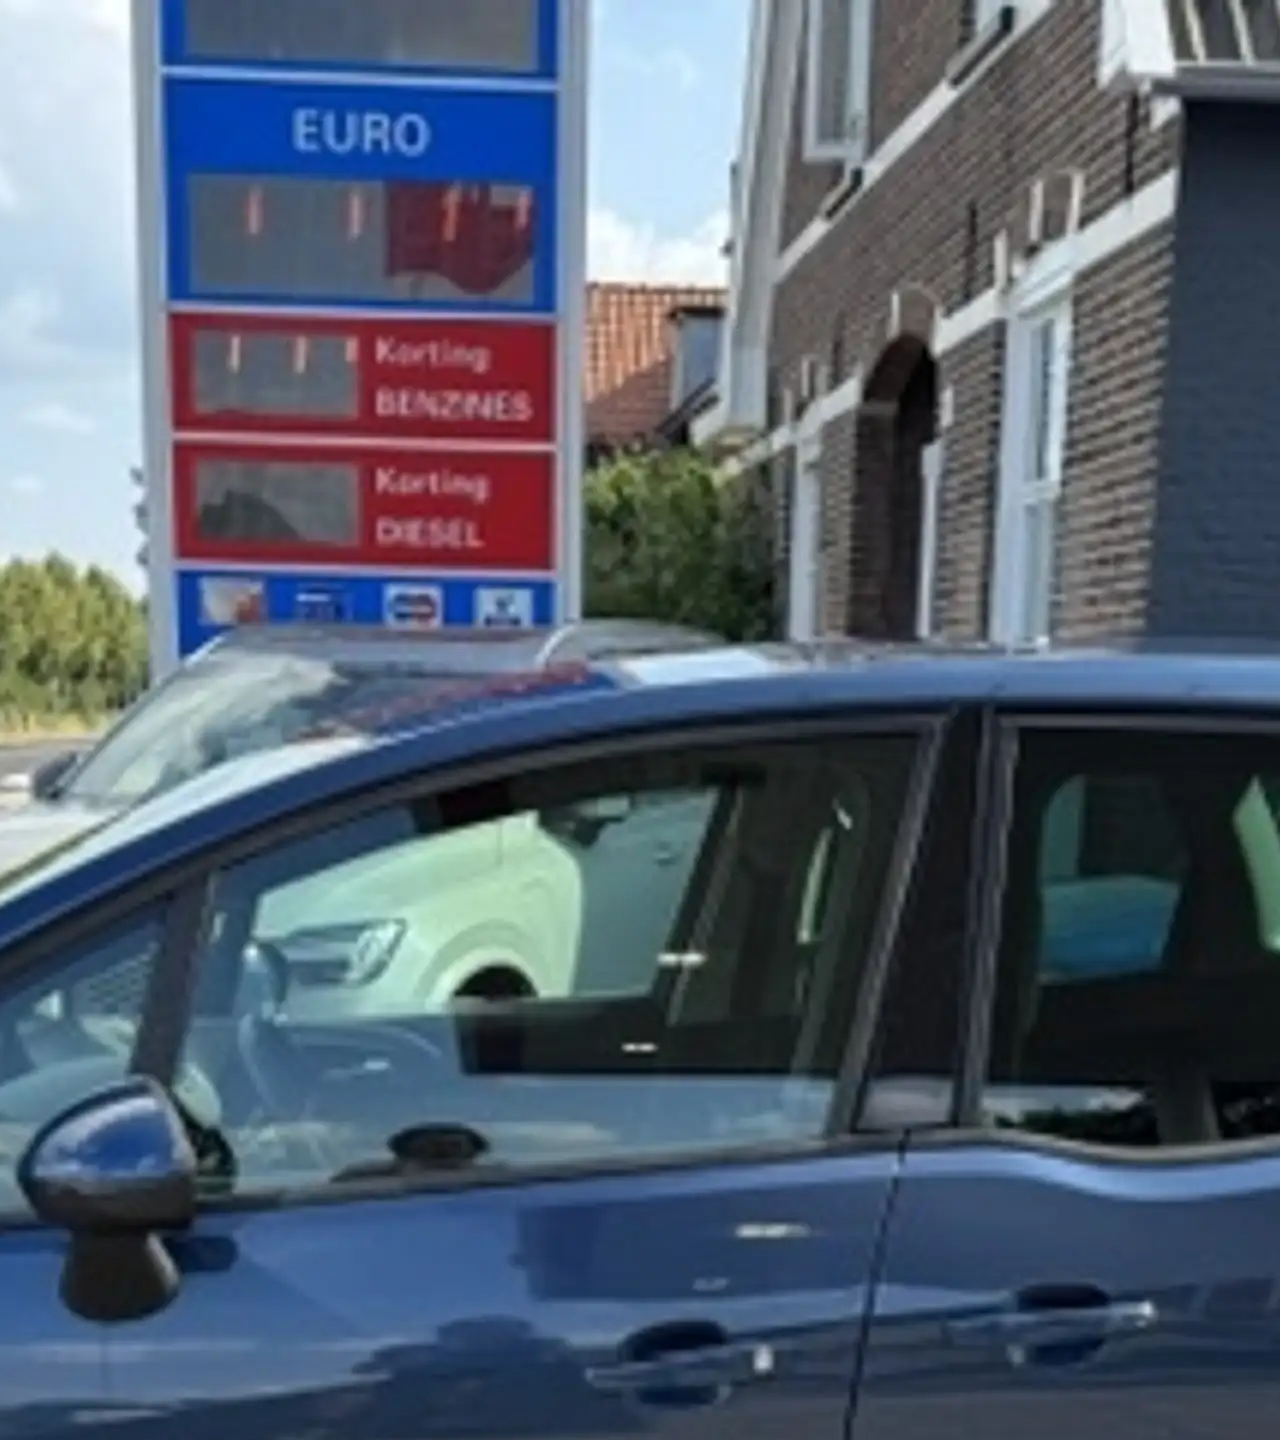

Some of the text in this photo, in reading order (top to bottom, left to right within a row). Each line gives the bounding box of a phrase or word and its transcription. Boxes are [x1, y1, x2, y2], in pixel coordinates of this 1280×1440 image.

[292, 107, 431, 157] EURO
[375, 336, 491, 374] Korting
[375, 387, 533, 421] BENZINES
[375, 467, 491, 505] Korting
[375, 516, 486, 549] DIESEL
